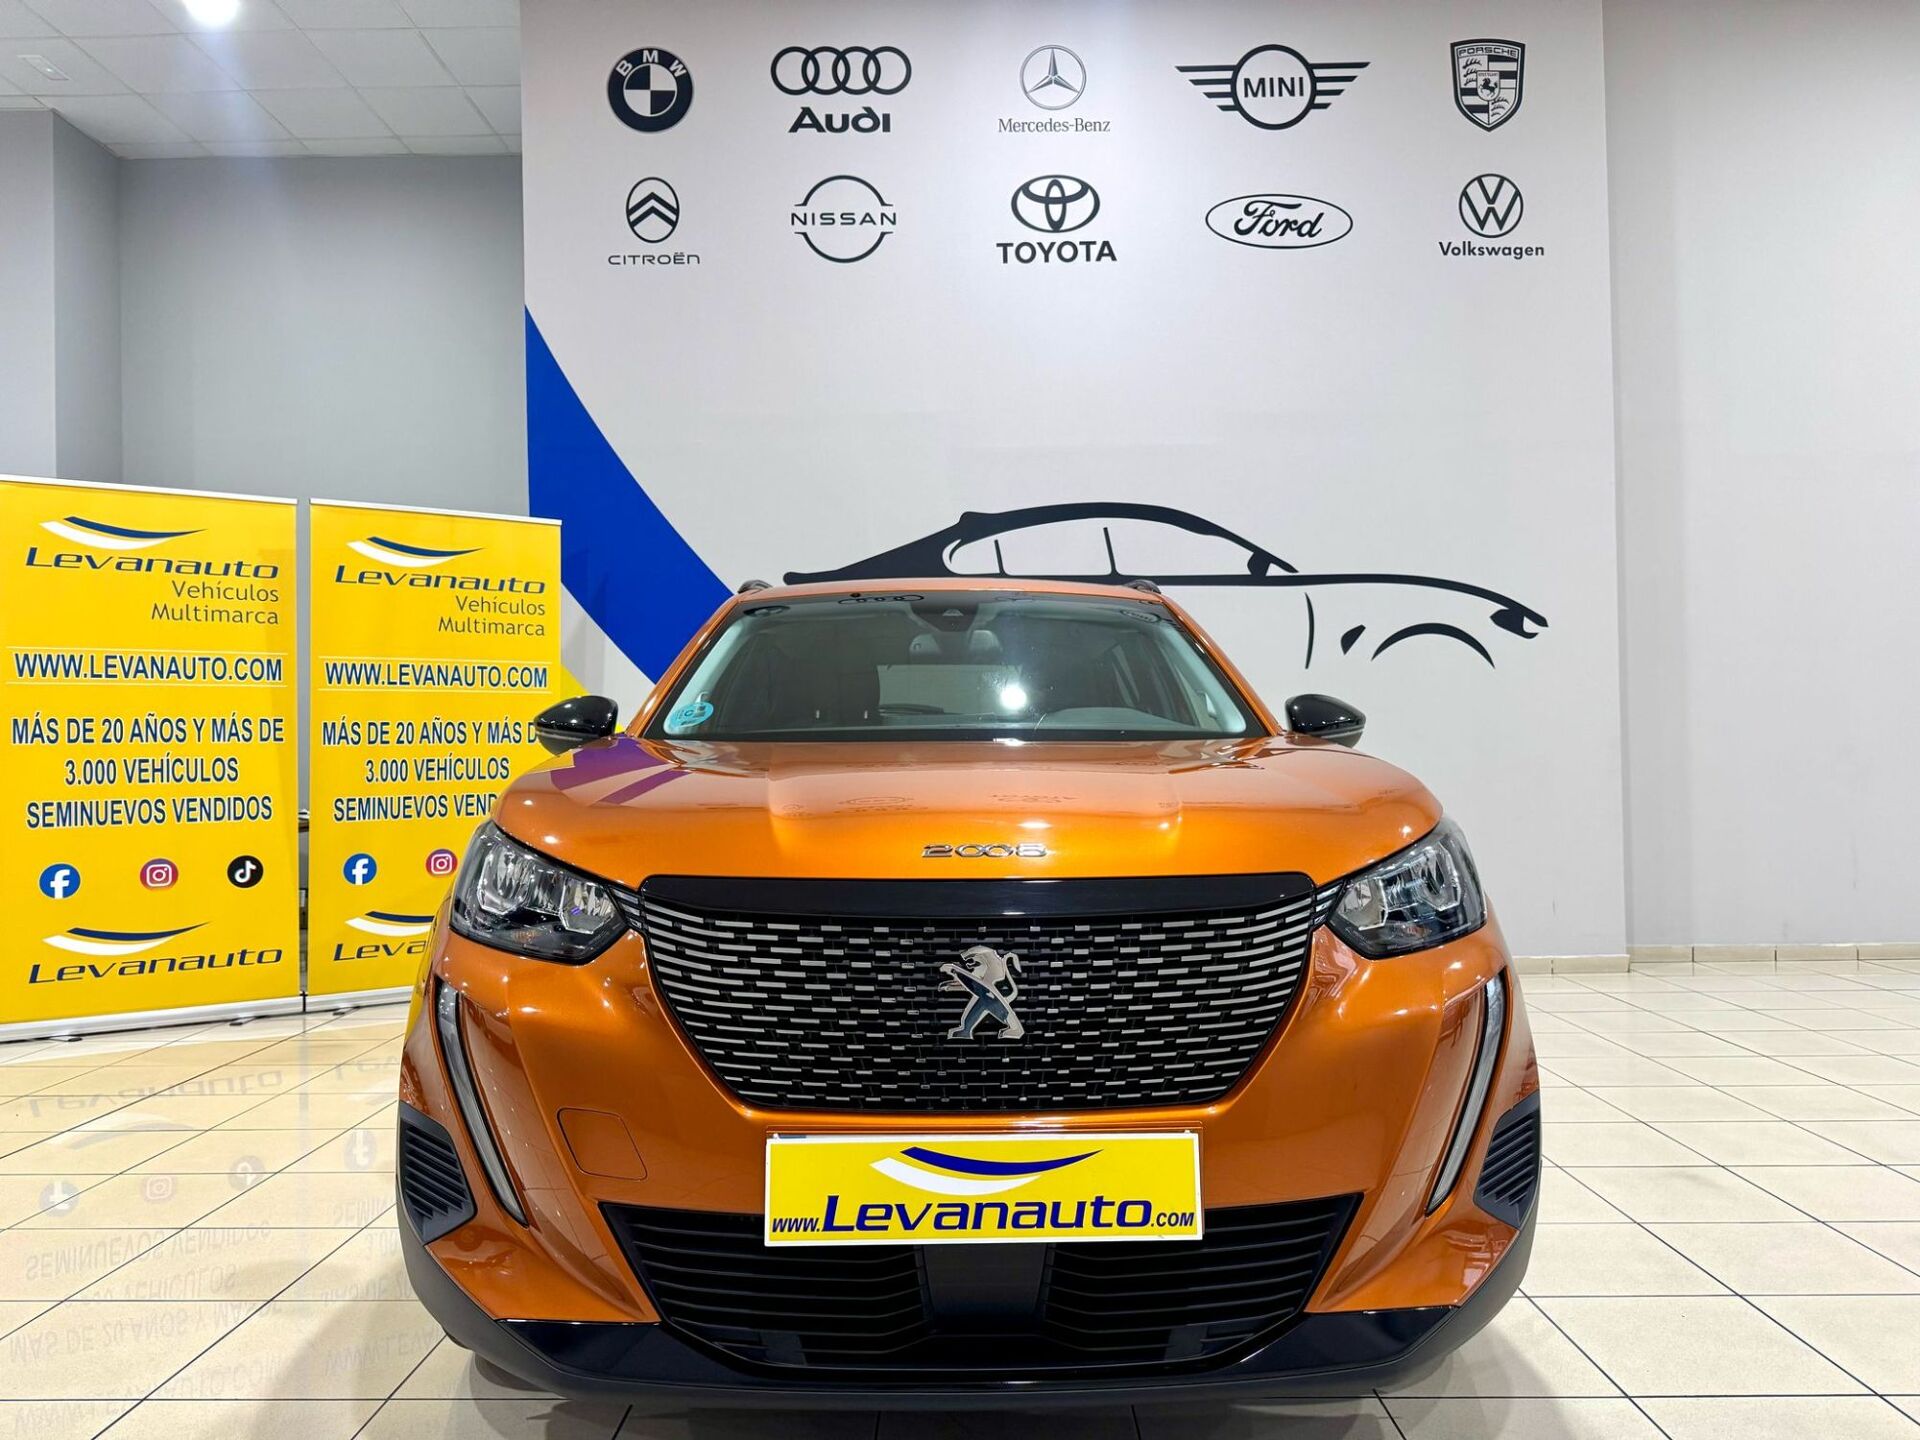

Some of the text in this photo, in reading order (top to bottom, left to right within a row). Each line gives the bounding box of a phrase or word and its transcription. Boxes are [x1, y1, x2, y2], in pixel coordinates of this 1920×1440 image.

[615, 49, 687, 77] BMW
[1458, 46, 1517, 57] PORSCHE
[1243, 76, 1304, 98] MINI
[788, 106, 891, 133] Audi
[999, 117, 1110, 132] Mercedes-Benz
[790, 212, 897, 226] NISSAN
[1233, 200, 1325, 238] Ford
[607, 251, 701, 266] CITROËN
[996, 240, 1117, 264] TOYOTA
[1438, 240, 1545, 260] Volkswagen
[26, 547, 279, 579] Levanauto
[171, 580, 279, 603] Vehículos
[335, 565, 546, 594] Levanauto
[151, 603, 278, 625] Multimarca
[455, 595, 545, 615] Vehículos
[438, 617, 545, 636] Multimarca
[14, 653, 282, 682] WWW.LEVANAUTO.COM
[325, 662, 547, 688] WWW.LEVANAUTO.COM
[12, 712, 284, 744] MÁS DE 20 AÑOS Y MÁS DE
[322, 716, 537, 746] MÁS DE 20 AÑOS Y MÁS D
[65, 752, 239, 786] 3.000 VEHÍCULOS
[365, 752, 510, 783] 3.000 VEHÍCULOS
[26, 795, 273, 829] SEMINUEVOS VENDIDOS
[333, 794, 448, 822] SEMINUEVOS
[922, 843, 1047, 858] 2008
[28, 949, 283, 984] Levanauto
